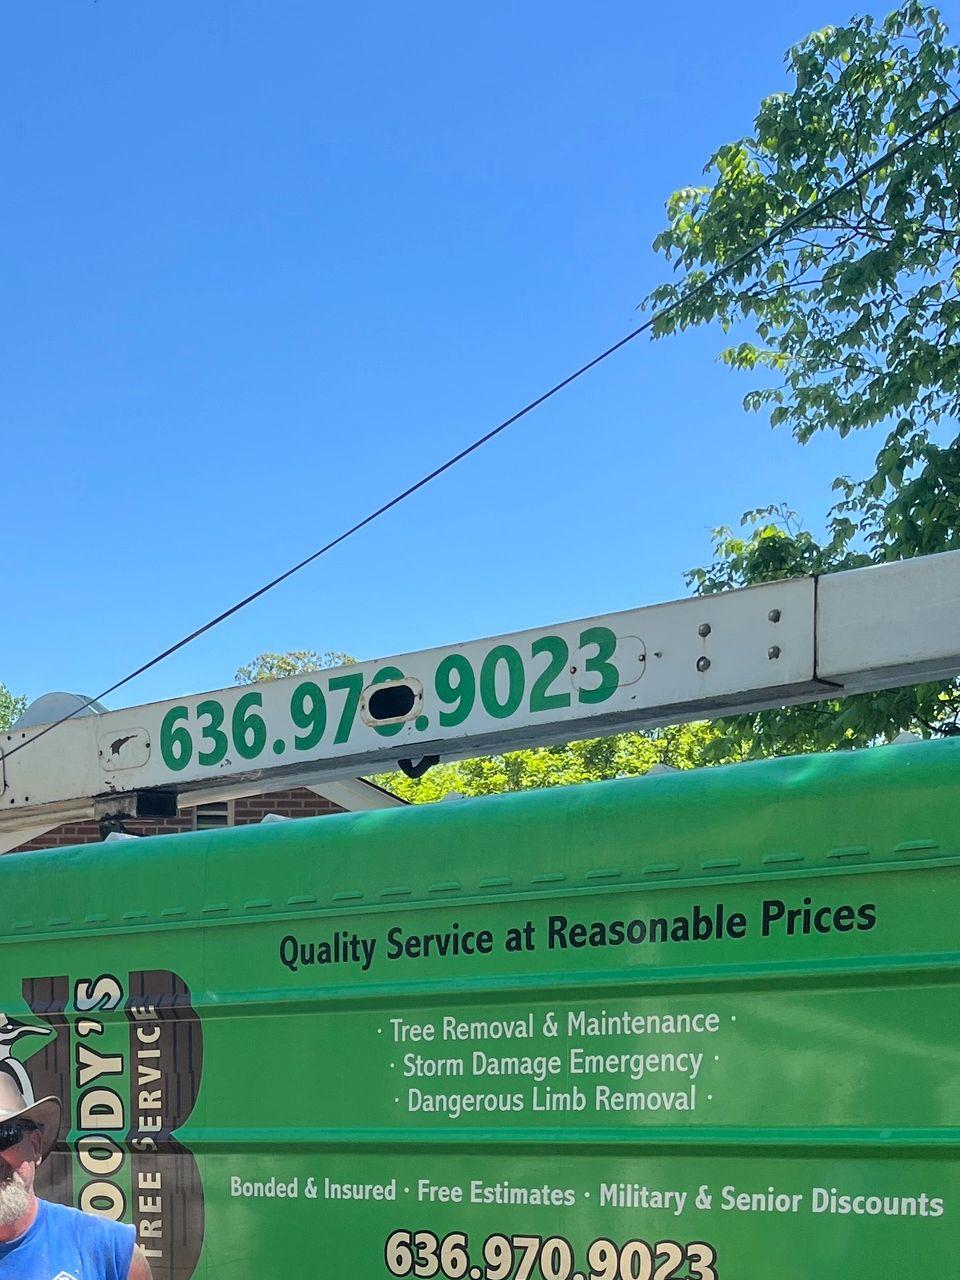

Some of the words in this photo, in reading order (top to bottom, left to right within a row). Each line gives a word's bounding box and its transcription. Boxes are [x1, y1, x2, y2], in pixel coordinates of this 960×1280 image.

[279, 933, 377, 971] Quality
[386, 926, 493, 961] Service
[505, 922, 536, 952] at
[547, 904, 747, 950] Reasonable
[760, 897, 877, 937] Prices
[390, 1018, 435, 1042] Tree
[442, 1013, 534, 1041] Removal
[542, 1011, 558, 1038] &
[567, 1010, 720, 1037] Maintenance
[131, 1004, 162, 1151] SERVICE
[403, 1053, 464, 1077] Storm
[472, 1050, 561, 1082] Damage
[570, 1048, 703, 1080] Emergency
[74, 973, 127, 1221] OODY'S
[408, 1088, 524, 1119] Dangerous
[532, 1086, 586, 1112] Limb
[595, 1085, 696, 1111] Removal
[138, 1172, 163, 1258] TREE
[230, 1176, 298, 1198] Bonded
[304, 1177, 318, 1199] &
[324, 1178, 396, 1201] Insured
[417, 1179, 463, 1203] Free
[470, 1181, 576, 1207] Estimates
[599, 1183, 687, 1216] Military
[695, 1185, 712, 1210] &
[721, 1185, 803, 1213] Senior
[811, 1187, 944, 1217] Discounts
